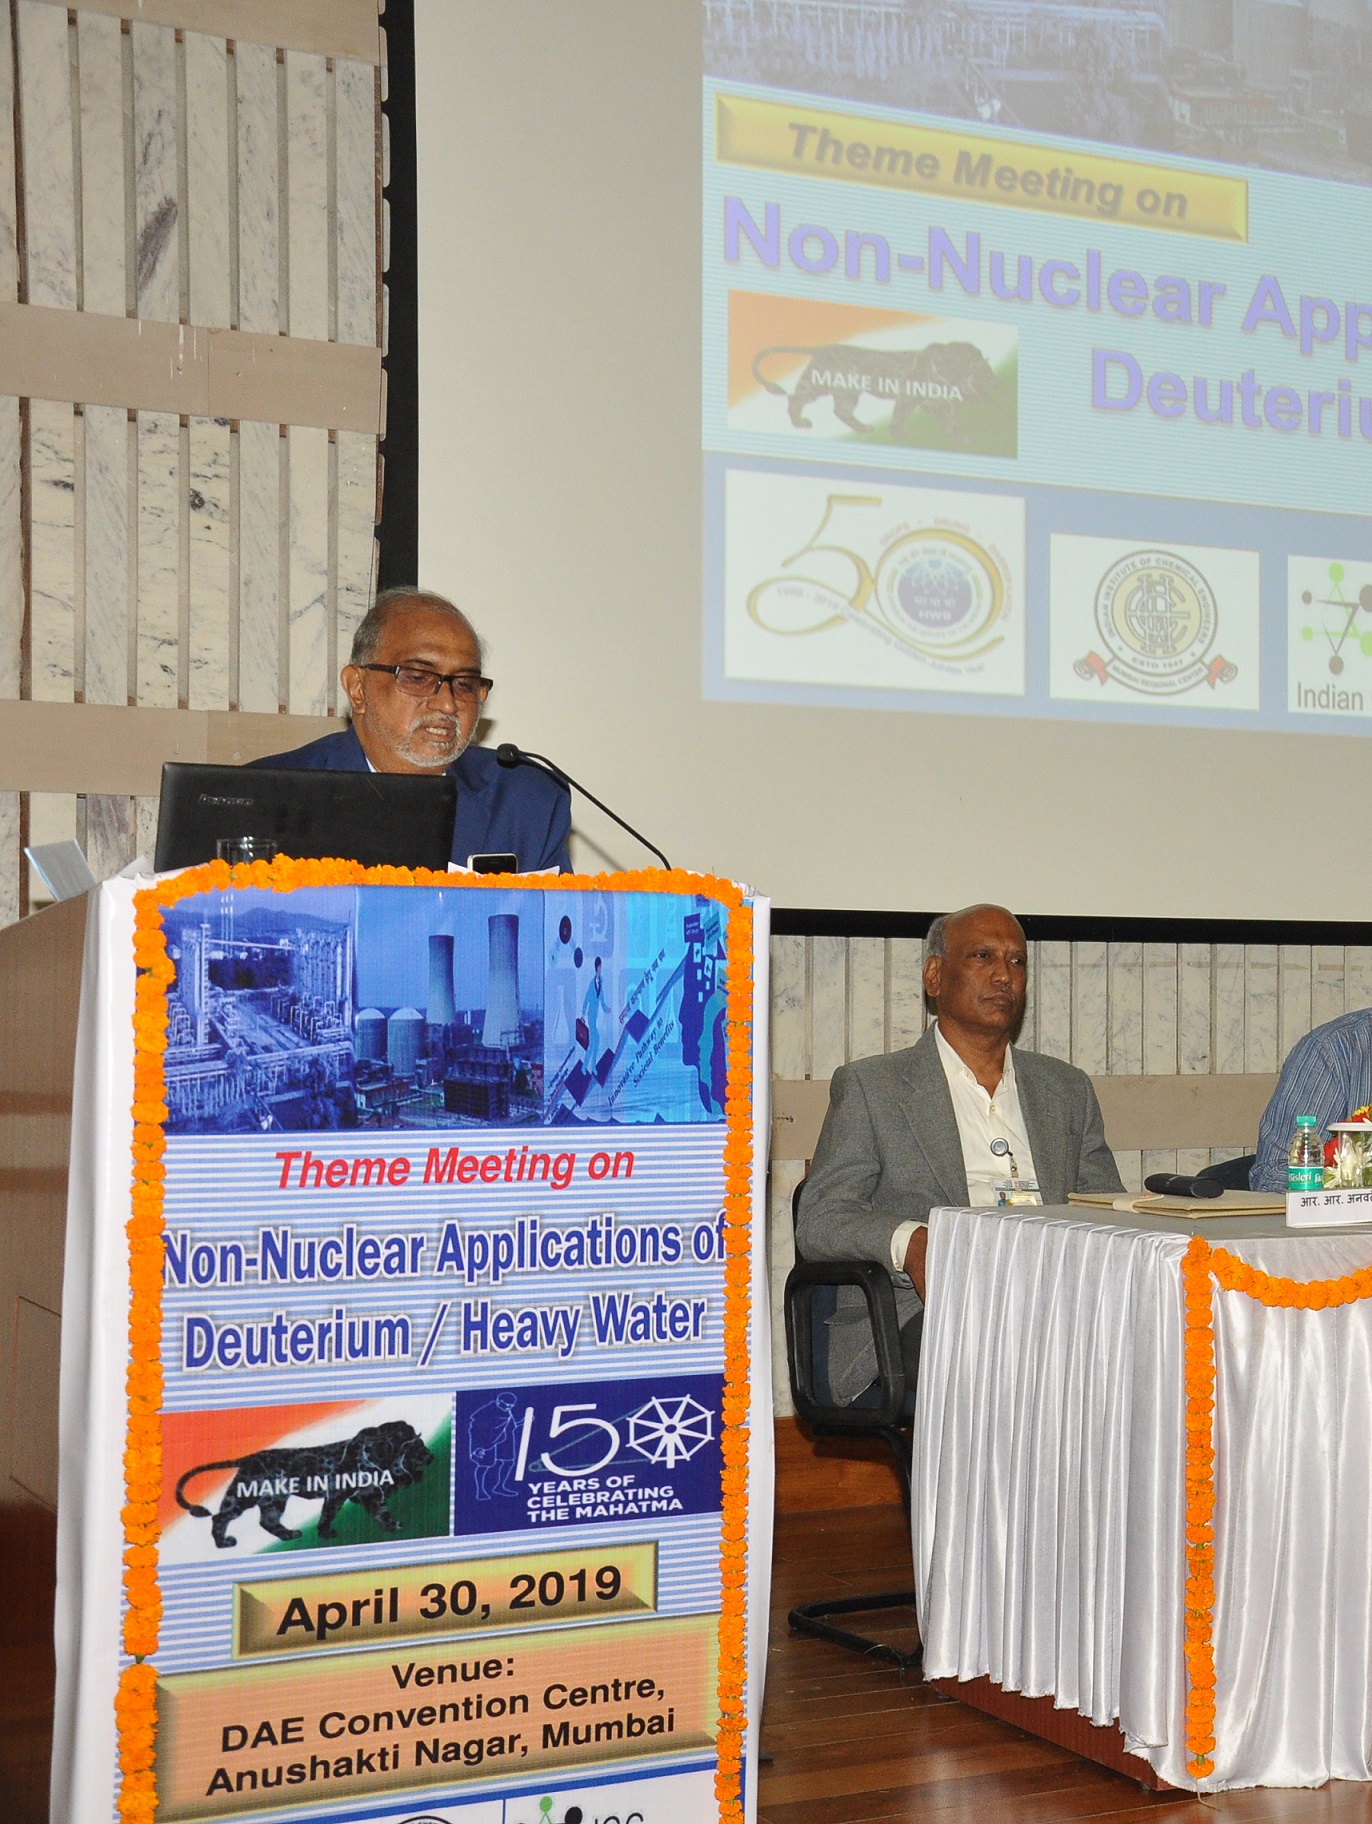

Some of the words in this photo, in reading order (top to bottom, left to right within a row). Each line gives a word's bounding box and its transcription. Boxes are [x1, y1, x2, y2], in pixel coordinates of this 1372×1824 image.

[787, 122, 940, 181] Theme
[952, 150, 1125, 217] Meeting
[1136, 188, 1189, 219] on
[723, 196, 1228, 329] Non-Nuclear
[810, 368, 873, 394] MAKE
[878, 374, 900, 396] IN
[905, 379, 964, 403] INDIA
[1296, 682, 1365, 712] Indian
[274, 1151, 411, 1189] Theme
[422, 1146, 576, 1190] Meeting
[587, 1150, 636, 1178] on
[1288, 1171, 1312, 1183] Bisleri
[1300, 1196, 1320, 1208] आर.
[1323, 1194, 1343, 1206] आर.
[161, 1225, 425, 1286] Non-Nuclear
[436, 1212, 682, 1284] Applications
[693, 1211, 728, 1261] of
[184, 1305, 411, 1370] Deuterium
[420, 1303, 450, 1365] /
[462, 1299, 582, 1358] Heavy
[591, 1292, 707, 1344] Water
[236, 1476, 300, 1499] MAKE
[306, 1474, 329, 1493] IN
[334, 1469, 396, 1490] INDIA
[526, 1485, 675, 1508] CELEBRATING
[528, 1478, 601, 1495] YEARS
[605, 1474, 636, 1490] OF
[526, 1507, 570, 1524] THE
[575, 1497, 684, 1521] MAHATMA
[276, 1588, 400, 1641] April
[418, 1578, 492, 1621] 30,
[509, 1564, 623, 1609] 2019
[391, 1655, 516, 1690] Venue:
[220, 1717, 306, 1754] DAE
[318, 1689, 530, 1740] Convention
[542, 1675, 667, 1712] Centre,
[205, 1748, 400, 1797] Anushakti
[414, 1731, 530, 1770] Nagar,
[541, 1707, 676, 1750] Mumbai
